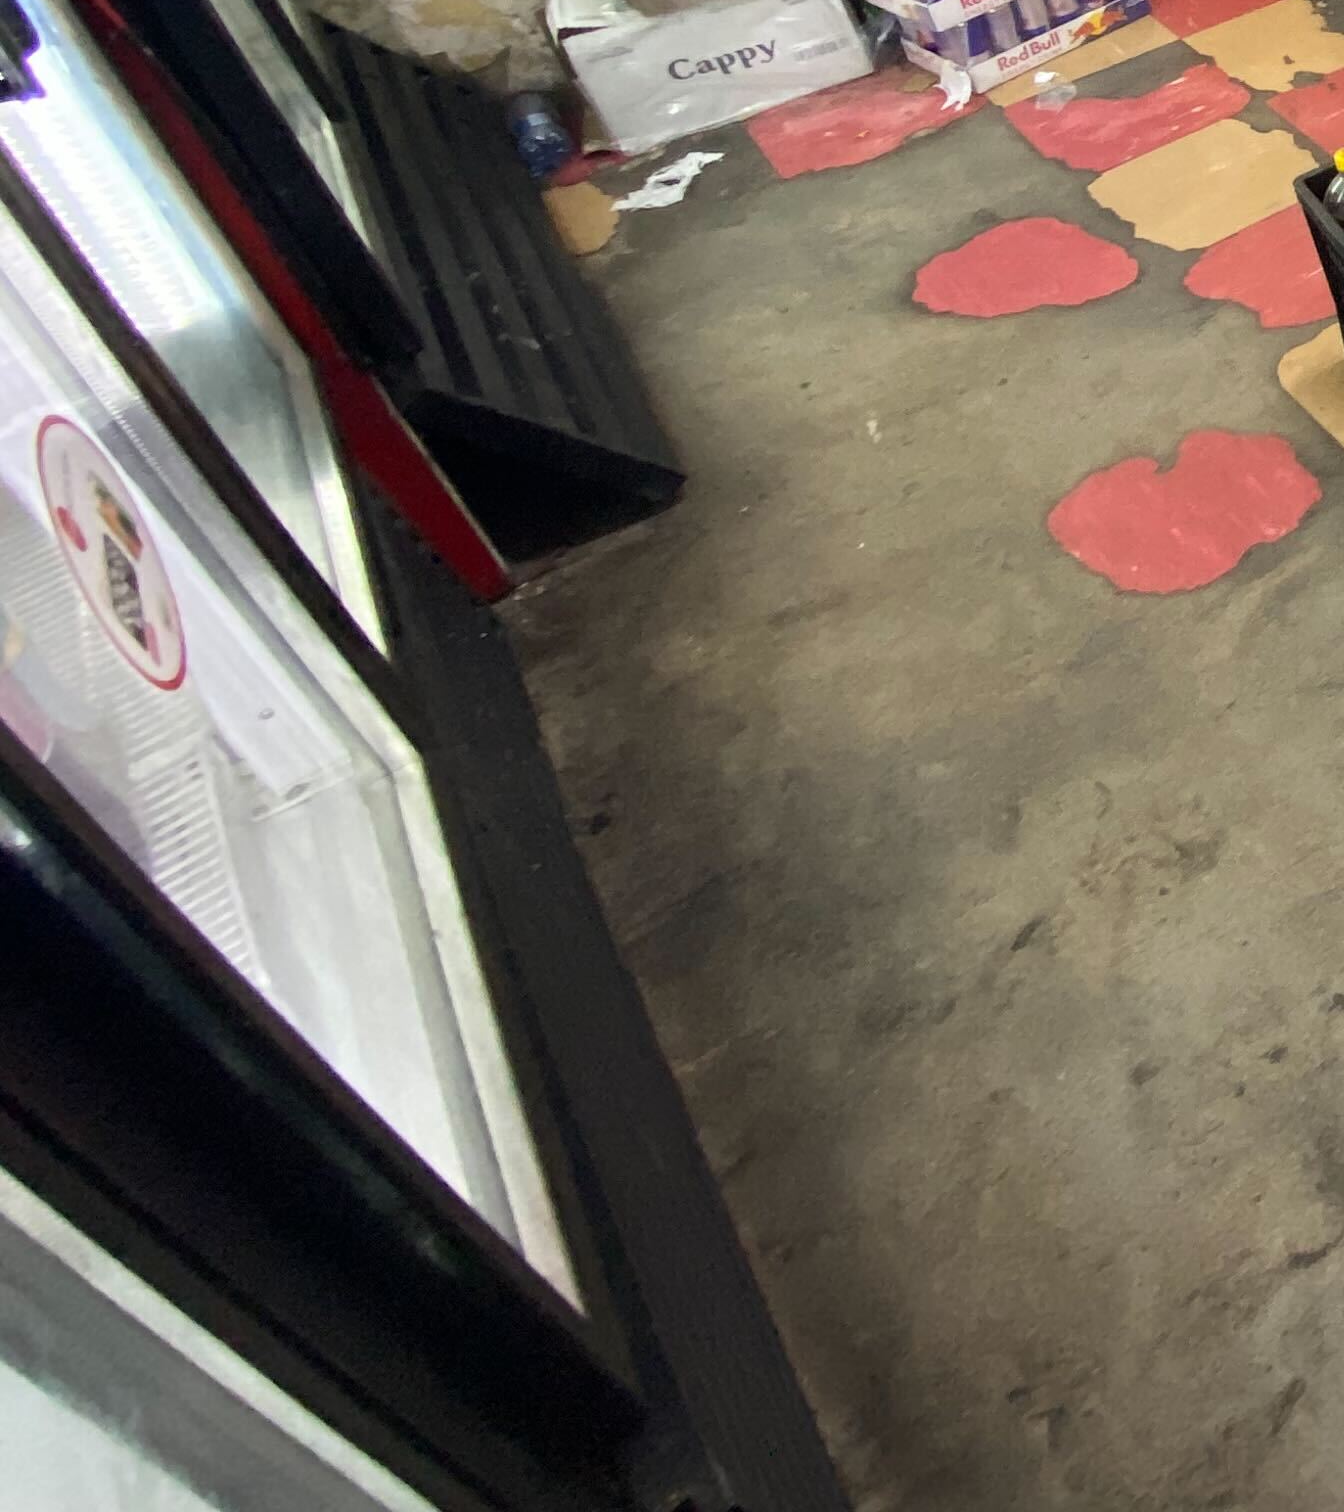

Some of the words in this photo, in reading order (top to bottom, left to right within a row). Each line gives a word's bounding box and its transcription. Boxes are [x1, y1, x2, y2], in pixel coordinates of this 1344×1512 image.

[667, 38, 777, 81] Cappy
[997, 49, 1030, 72] Red
[1030, 32, 1061, 56] Bull
